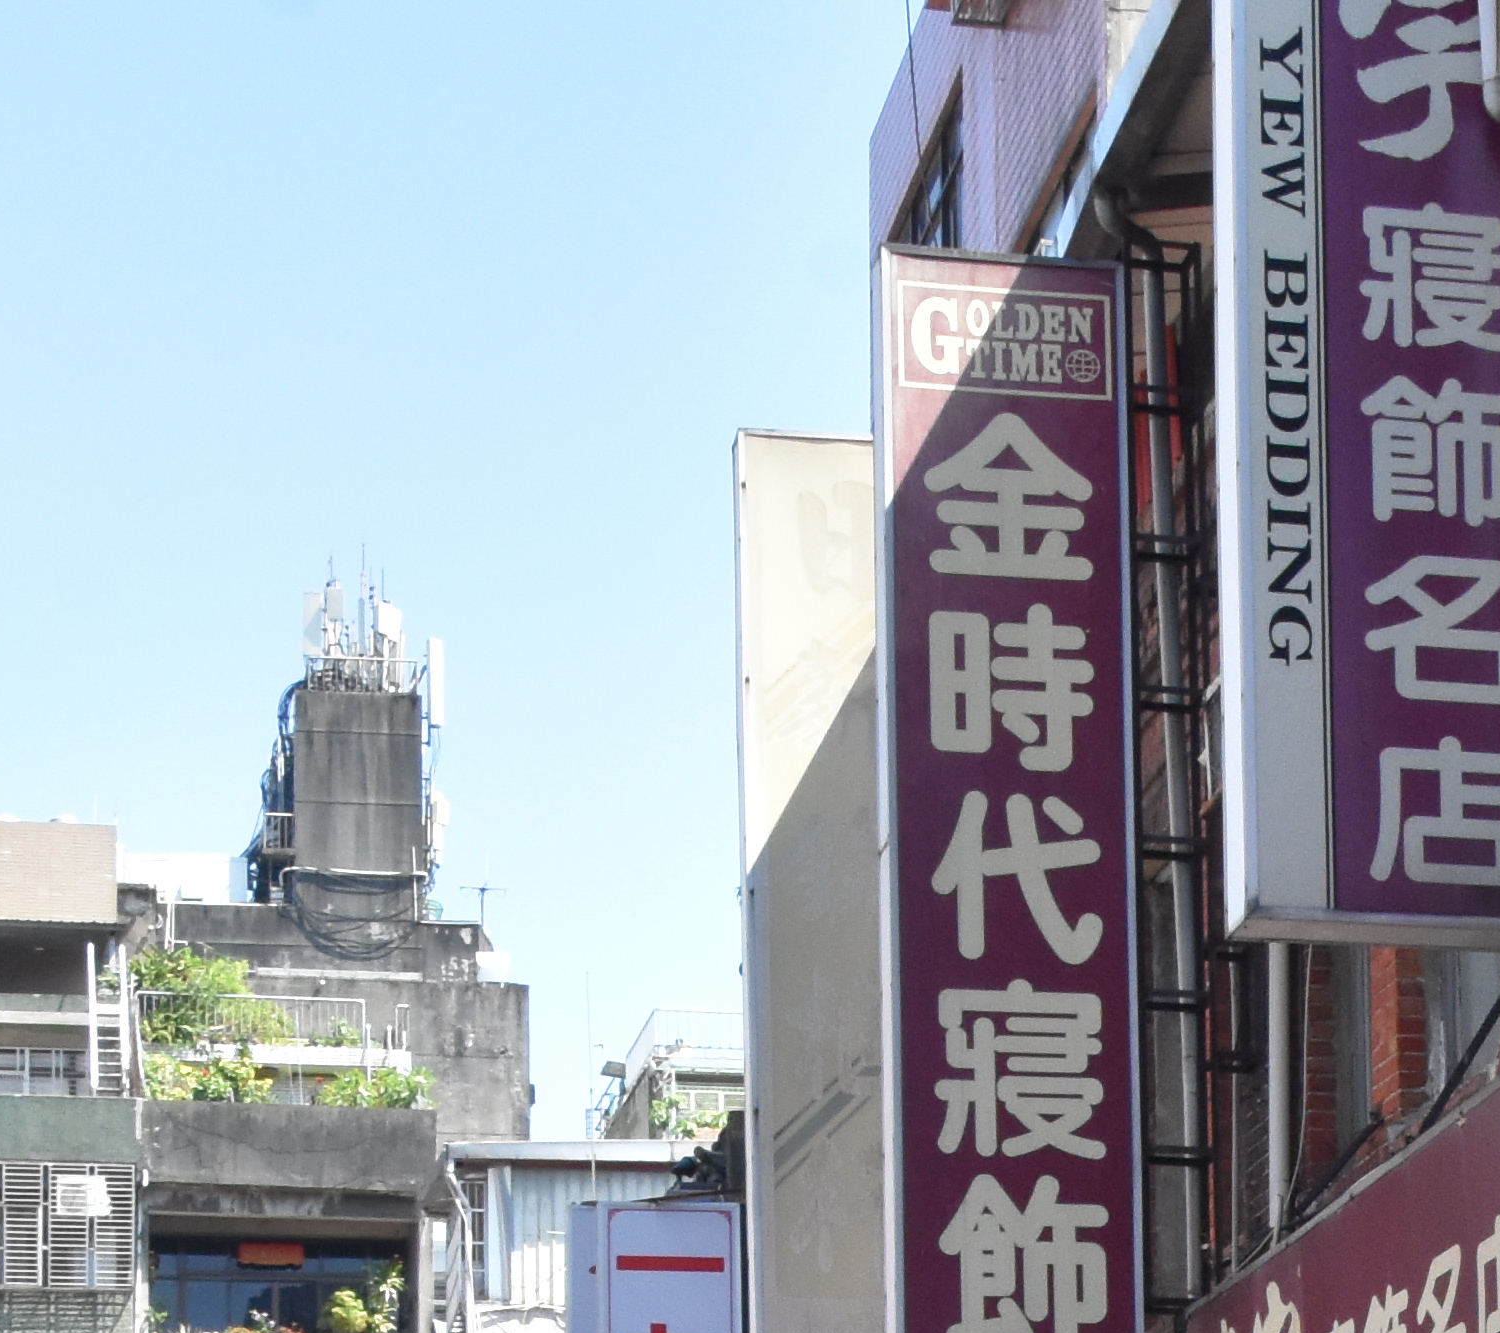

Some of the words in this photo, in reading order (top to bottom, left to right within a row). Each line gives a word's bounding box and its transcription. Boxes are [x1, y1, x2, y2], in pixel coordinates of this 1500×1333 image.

[1258, 26, 1307, 218] YEW
[911, 296, 1093, 376] GOLDEN
[966, 341, 1064, 385] TIME
[1262, 249, 1315, 668] BEDDING
